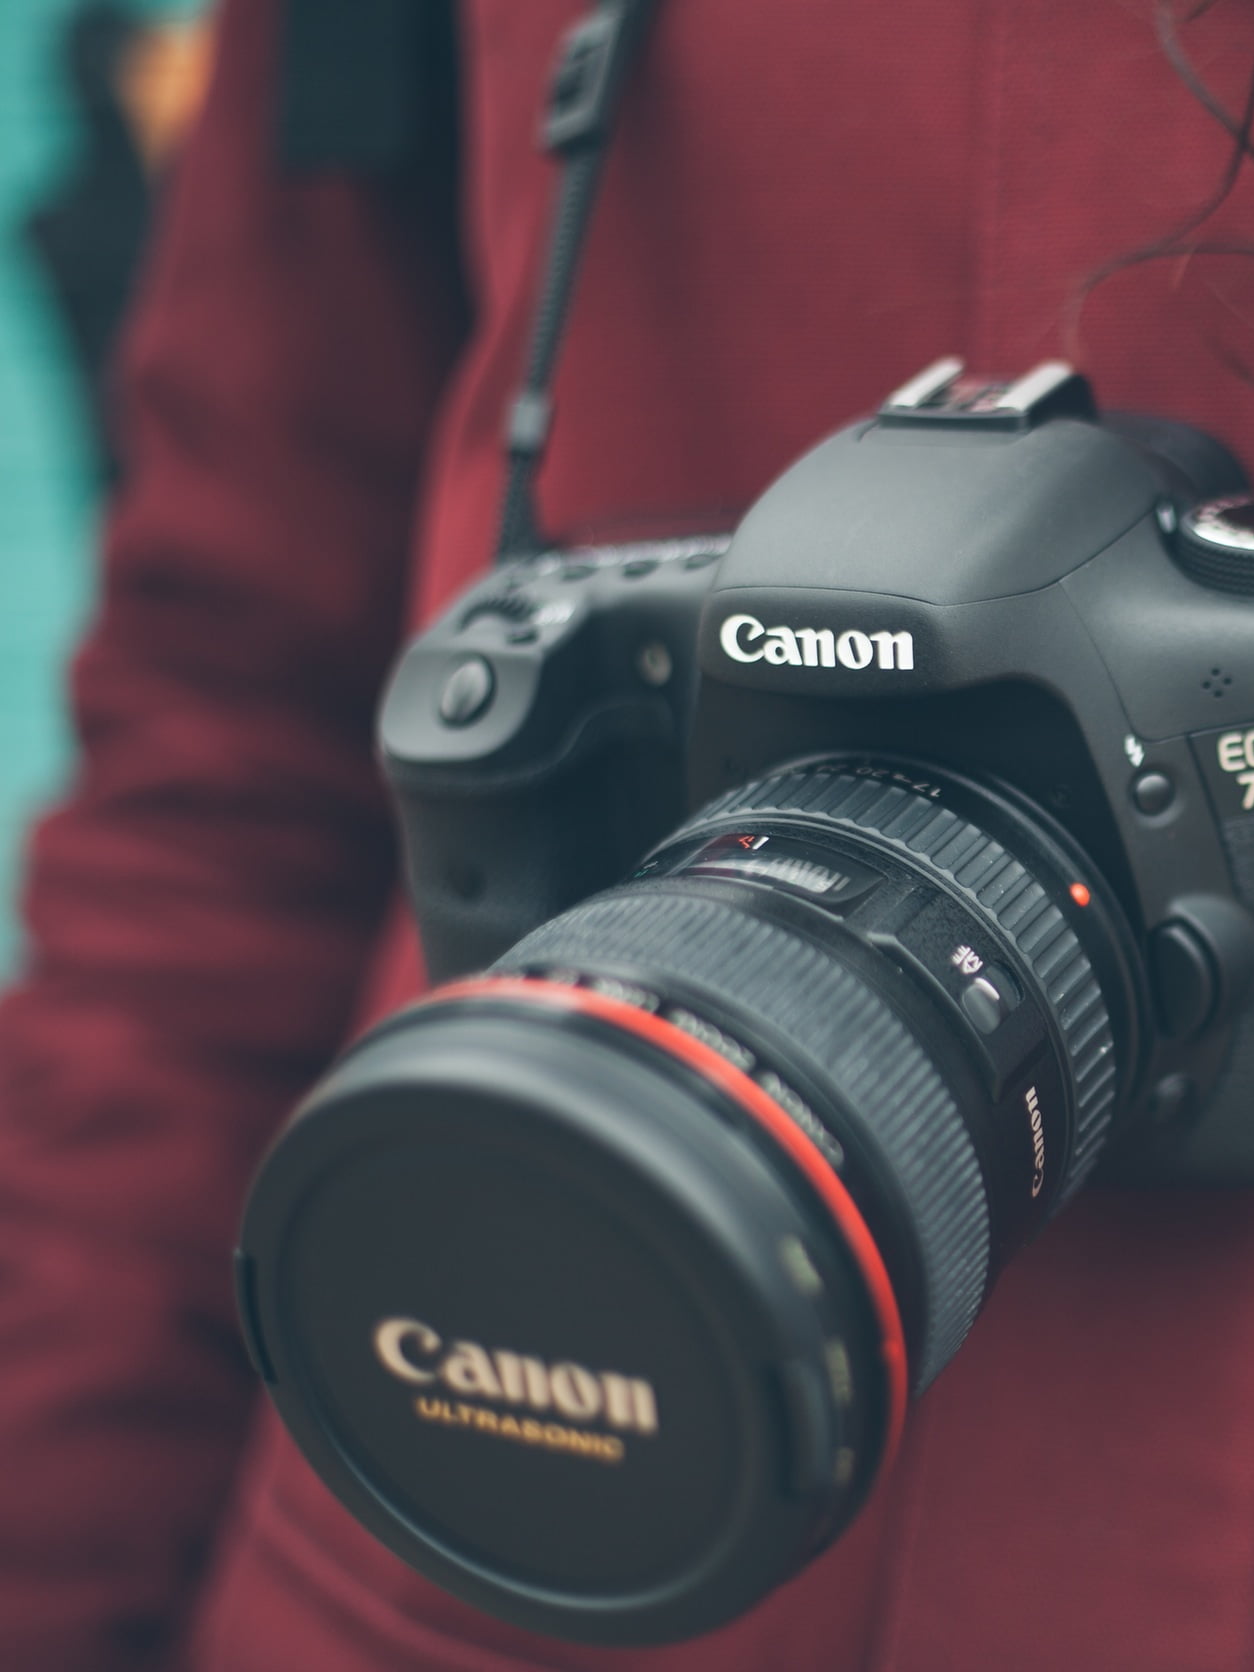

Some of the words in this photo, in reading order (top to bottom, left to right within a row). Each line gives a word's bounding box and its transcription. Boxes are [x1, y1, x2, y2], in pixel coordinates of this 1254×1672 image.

[719, 613, 914, 670] Canon
[1025, 1085, 1045, 1198] Canon
[374, 1316, 657, 1434] Canon
[417, 1397, 623, 1462] ULTRASONIC
